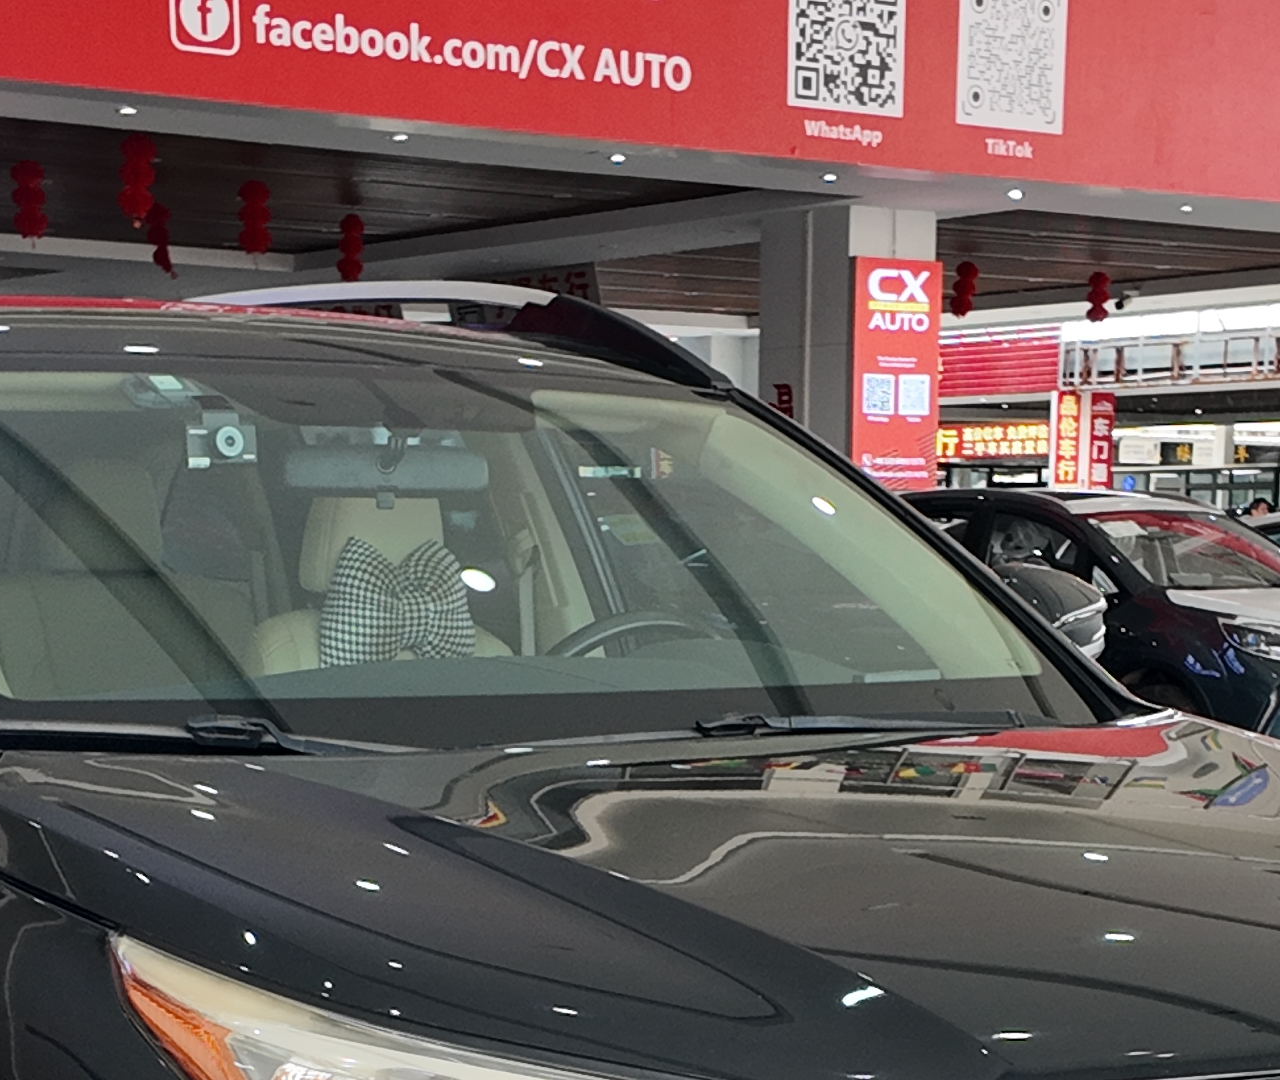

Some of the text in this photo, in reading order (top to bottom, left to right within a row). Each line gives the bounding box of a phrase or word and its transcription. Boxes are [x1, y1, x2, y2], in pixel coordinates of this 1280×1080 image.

[252, 4, 692, 91] facebook.com/CX AUTO
[804, 119, 883, 147] WhatsApp
[985, 138, 1033, 159] TikTok
[867, 268, 931, 302] CX
[868, 312, 930, 331] AUTO
[936, 428, 959, 456] 行
